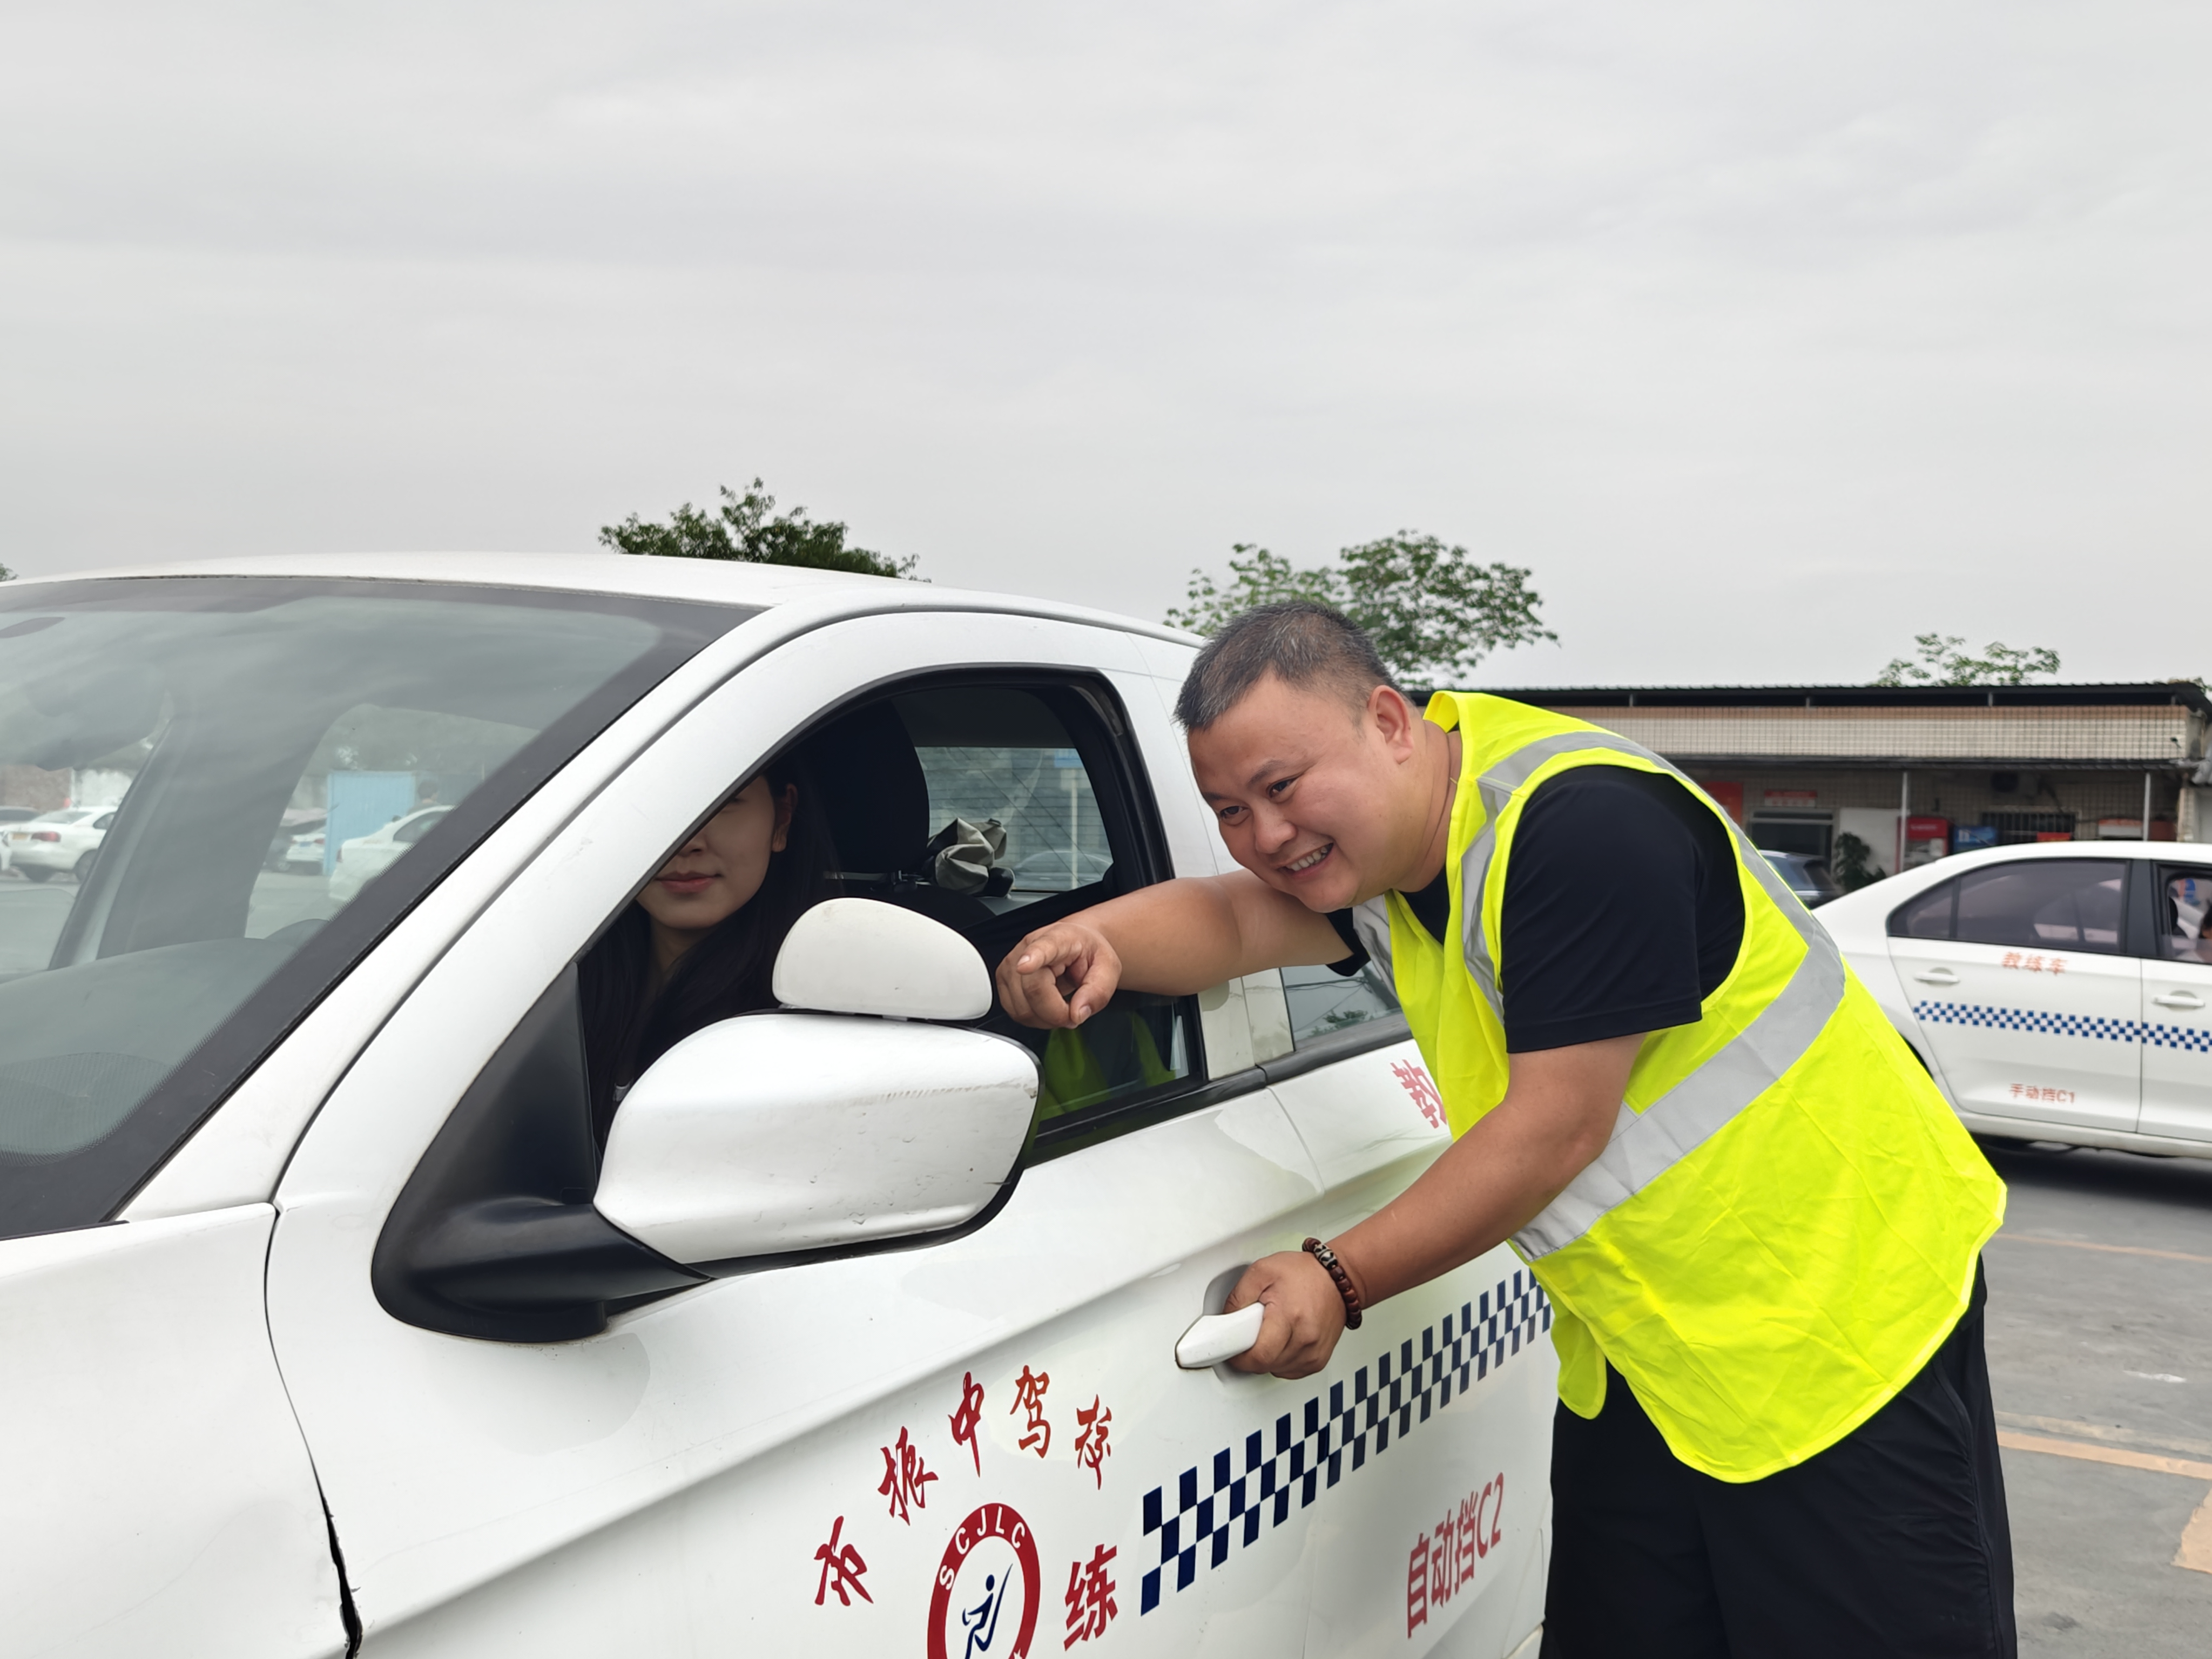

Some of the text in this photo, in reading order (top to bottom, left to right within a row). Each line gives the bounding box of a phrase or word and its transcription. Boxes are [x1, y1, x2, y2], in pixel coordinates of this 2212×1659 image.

[1390, 1059, 1447, 1129] 教
[939, 1506, 1026, 1590] SCJLC
[1407, 1473, 1504, 1639] 自动挡C2
[1064, 1544, 1118, 1651] 练
